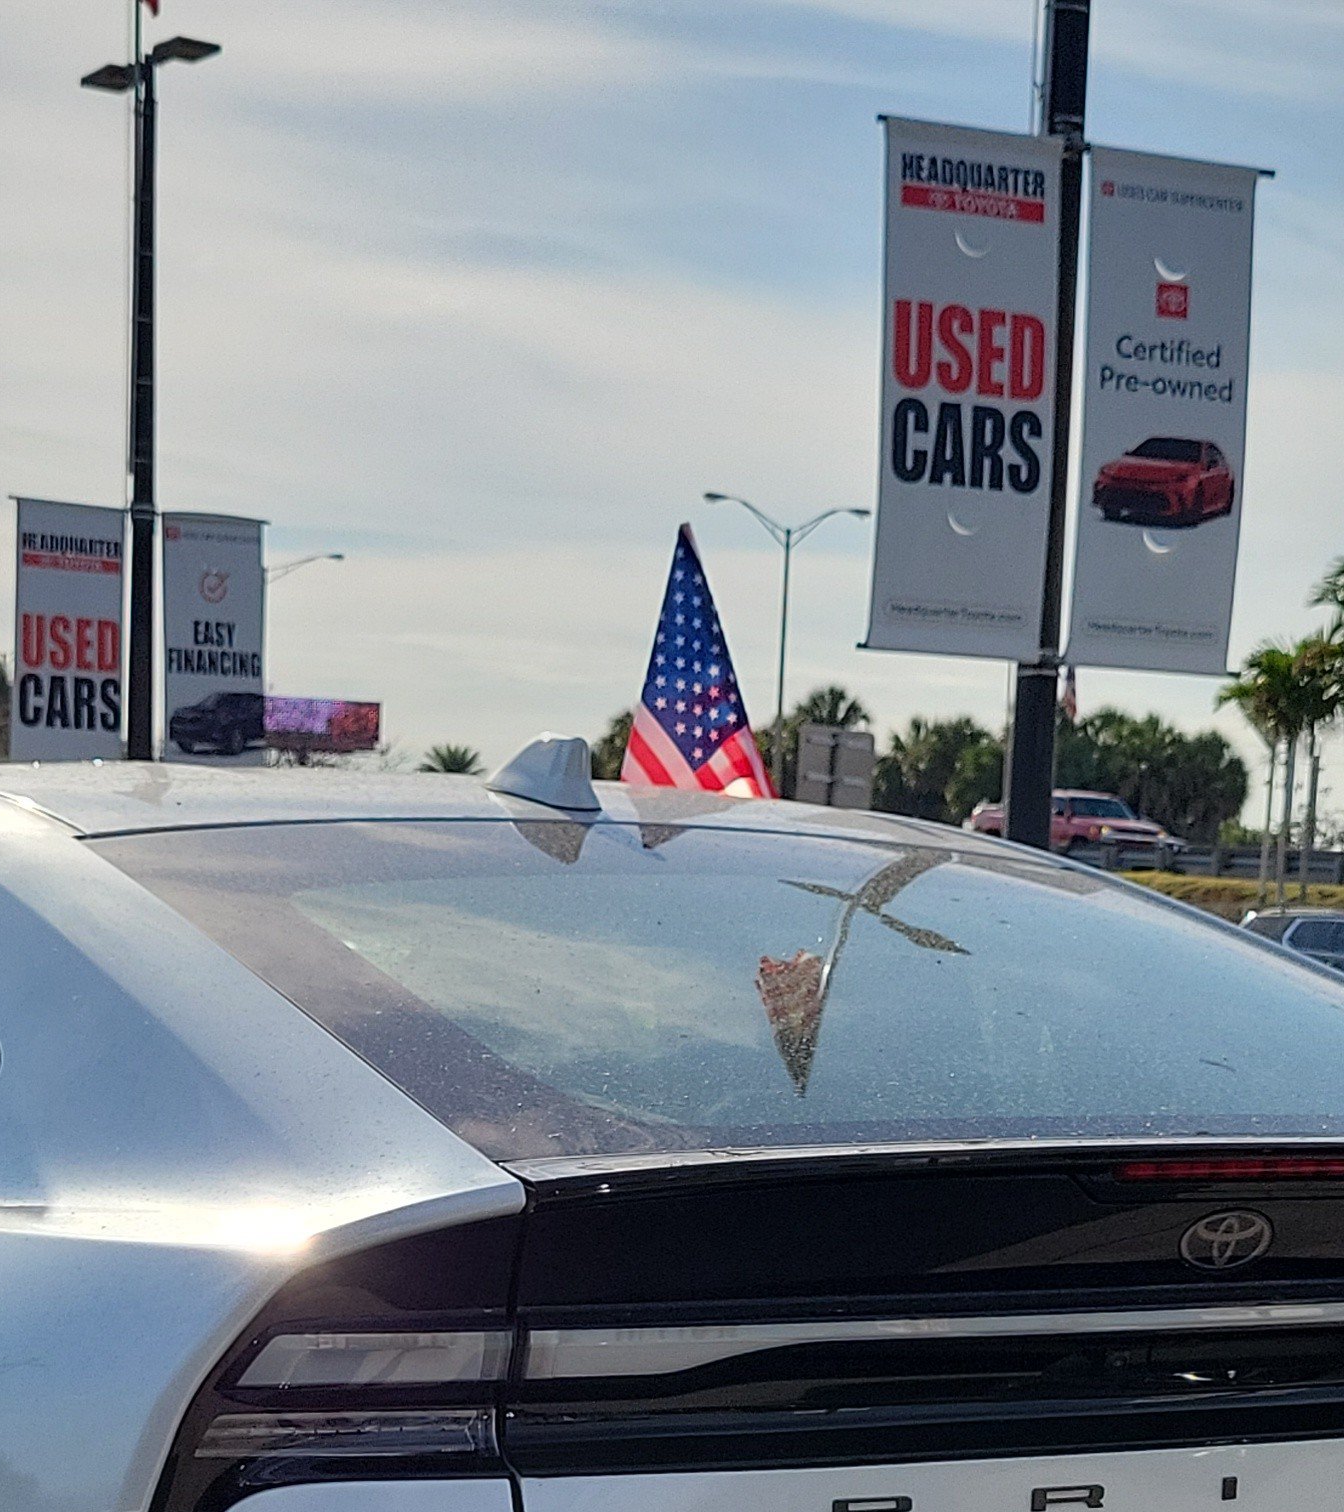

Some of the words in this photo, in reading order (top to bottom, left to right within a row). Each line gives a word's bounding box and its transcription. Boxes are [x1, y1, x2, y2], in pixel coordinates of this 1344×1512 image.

[901, 152, 1045, 199] HEADQUARTER
[893, 299, 1045, 401] USED
[1115, 334, 1221, 370] Certified
[1099, 366, 1233, 403] Pre-owned
[891, 398, 1043, 493] CARS
[22, 613, 120, 672] USED
[193, 620, 236, 647] EASY
[167, 648, 262, 679] FINANCING
[19, 673, 121, 731] CARS
